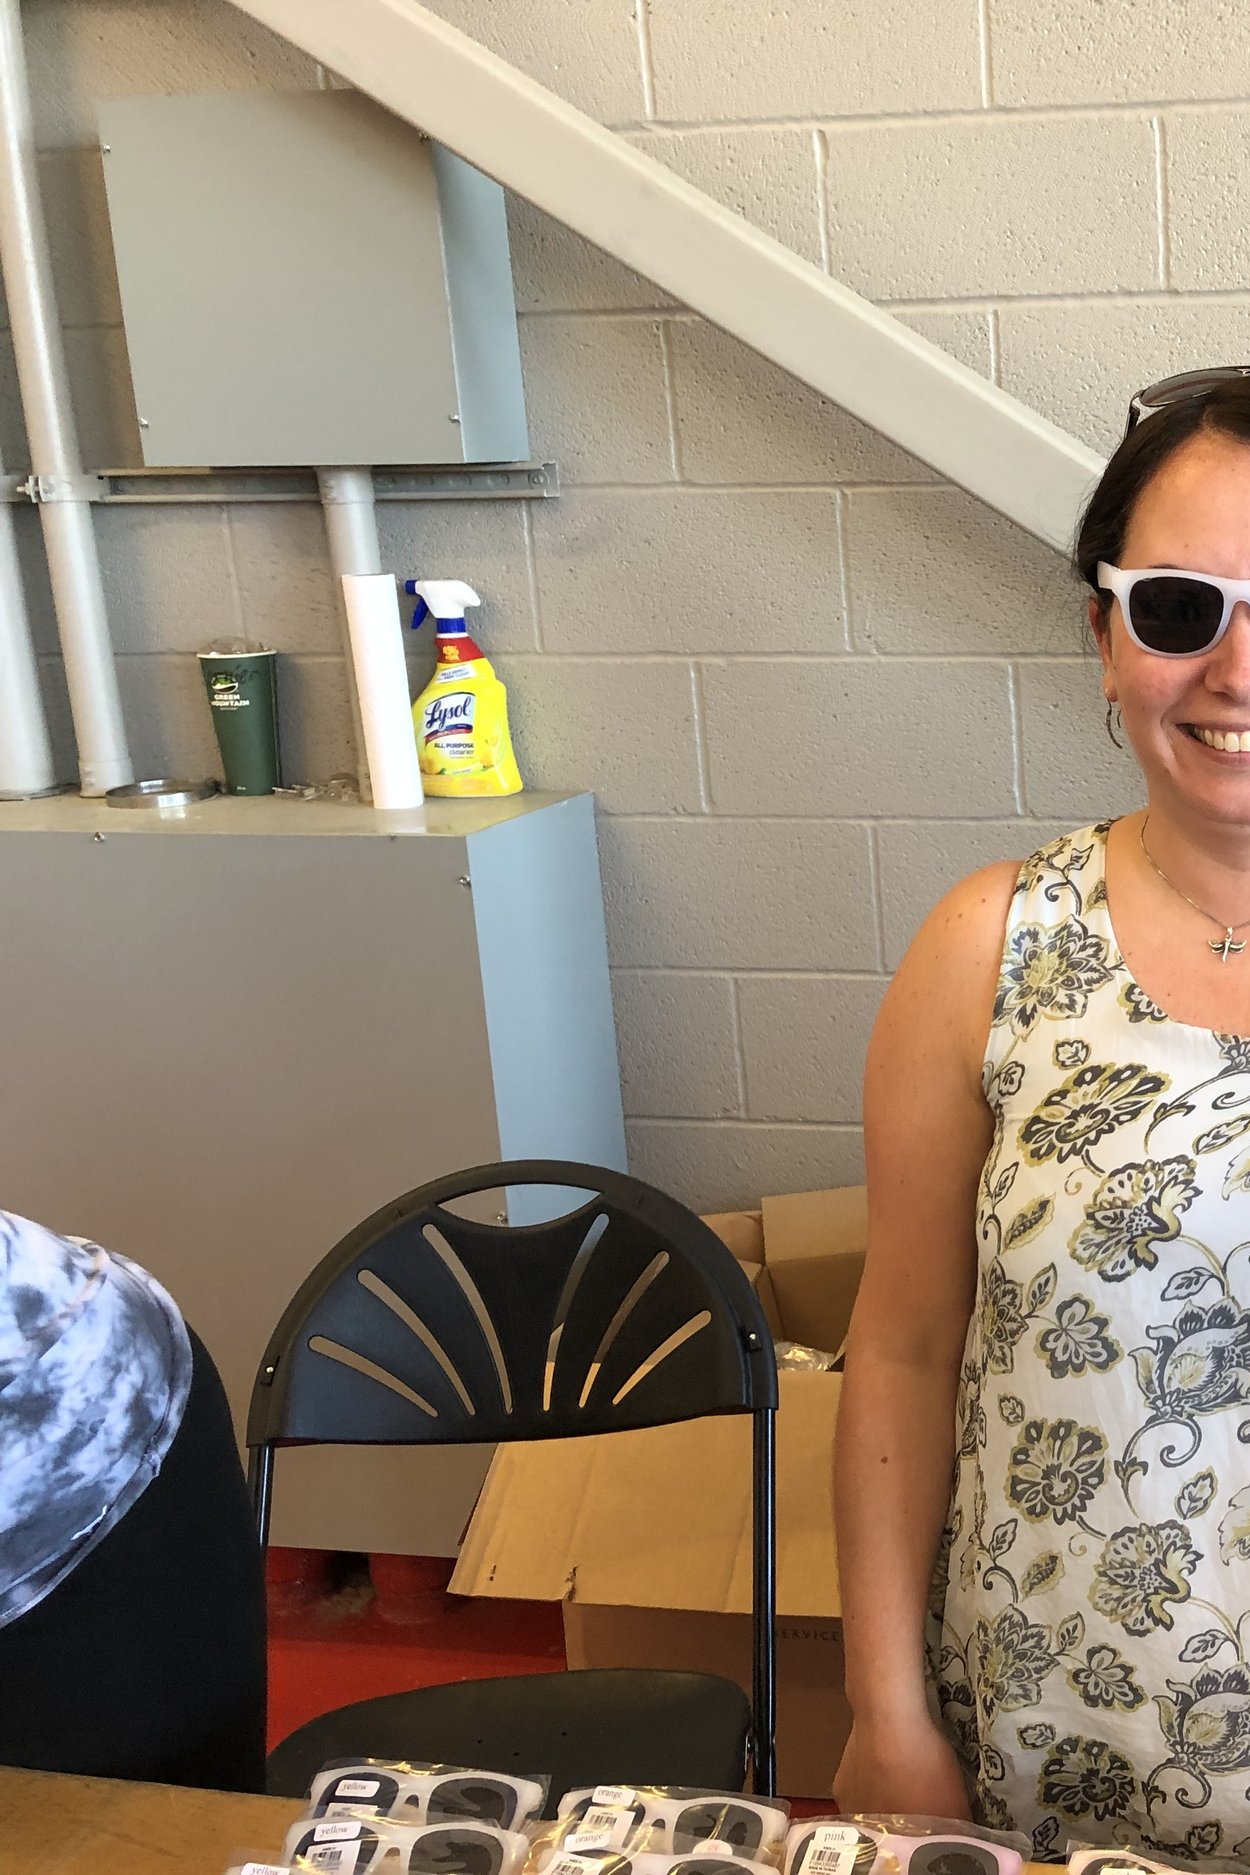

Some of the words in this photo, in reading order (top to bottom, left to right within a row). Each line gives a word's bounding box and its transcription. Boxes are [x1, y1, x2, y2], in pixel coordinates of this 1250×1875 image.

[425, 696, 471, 729] Lysol
[780, 1628, 841, 1642] ERVICE
[341, 1780, 367, 1791] yellow
[598, 1789, 623, 1800] orange
[320, 1825, 349, 1836] yellow
[824, 1830, 846, 1842] pink
[575, 1833, 603, 1844] orange
[251, 1864, 280, 1875] yellow
